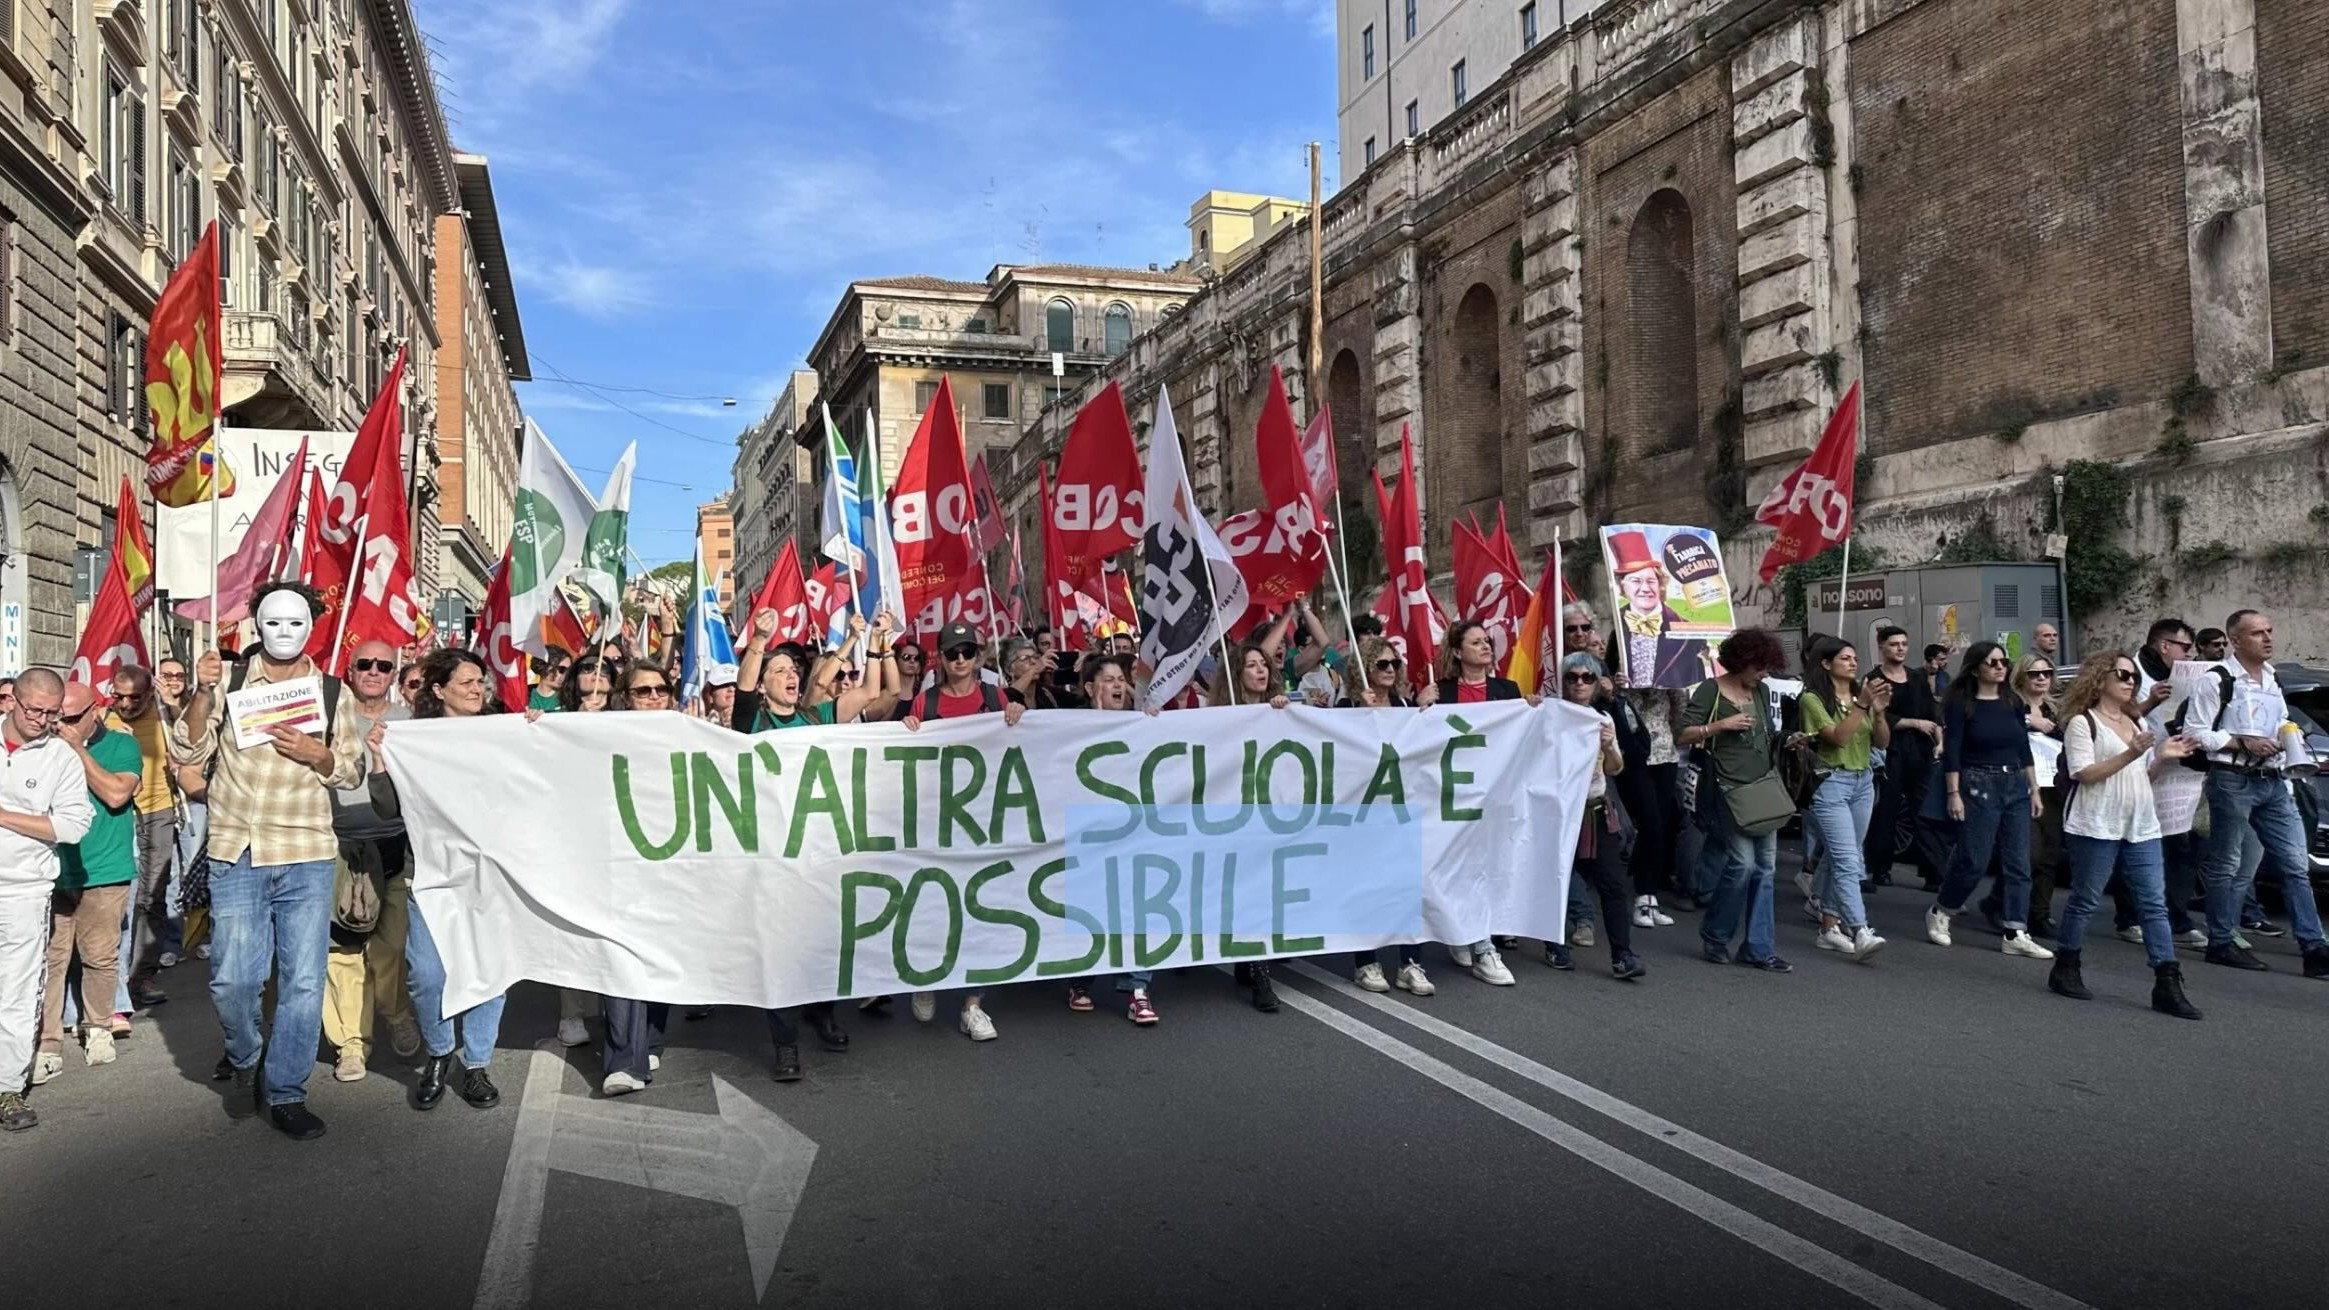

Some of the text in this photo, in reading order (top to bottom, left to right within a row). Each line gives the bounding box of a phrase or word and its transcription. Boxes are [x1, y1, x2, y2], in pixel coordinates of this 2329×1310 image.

[1823, 587, 1883, 605] nosono
[611, 713, 1486, 862] UN'ALTRA SCUOLA È
[838, 842, 1329, 997] POSSIBILE
